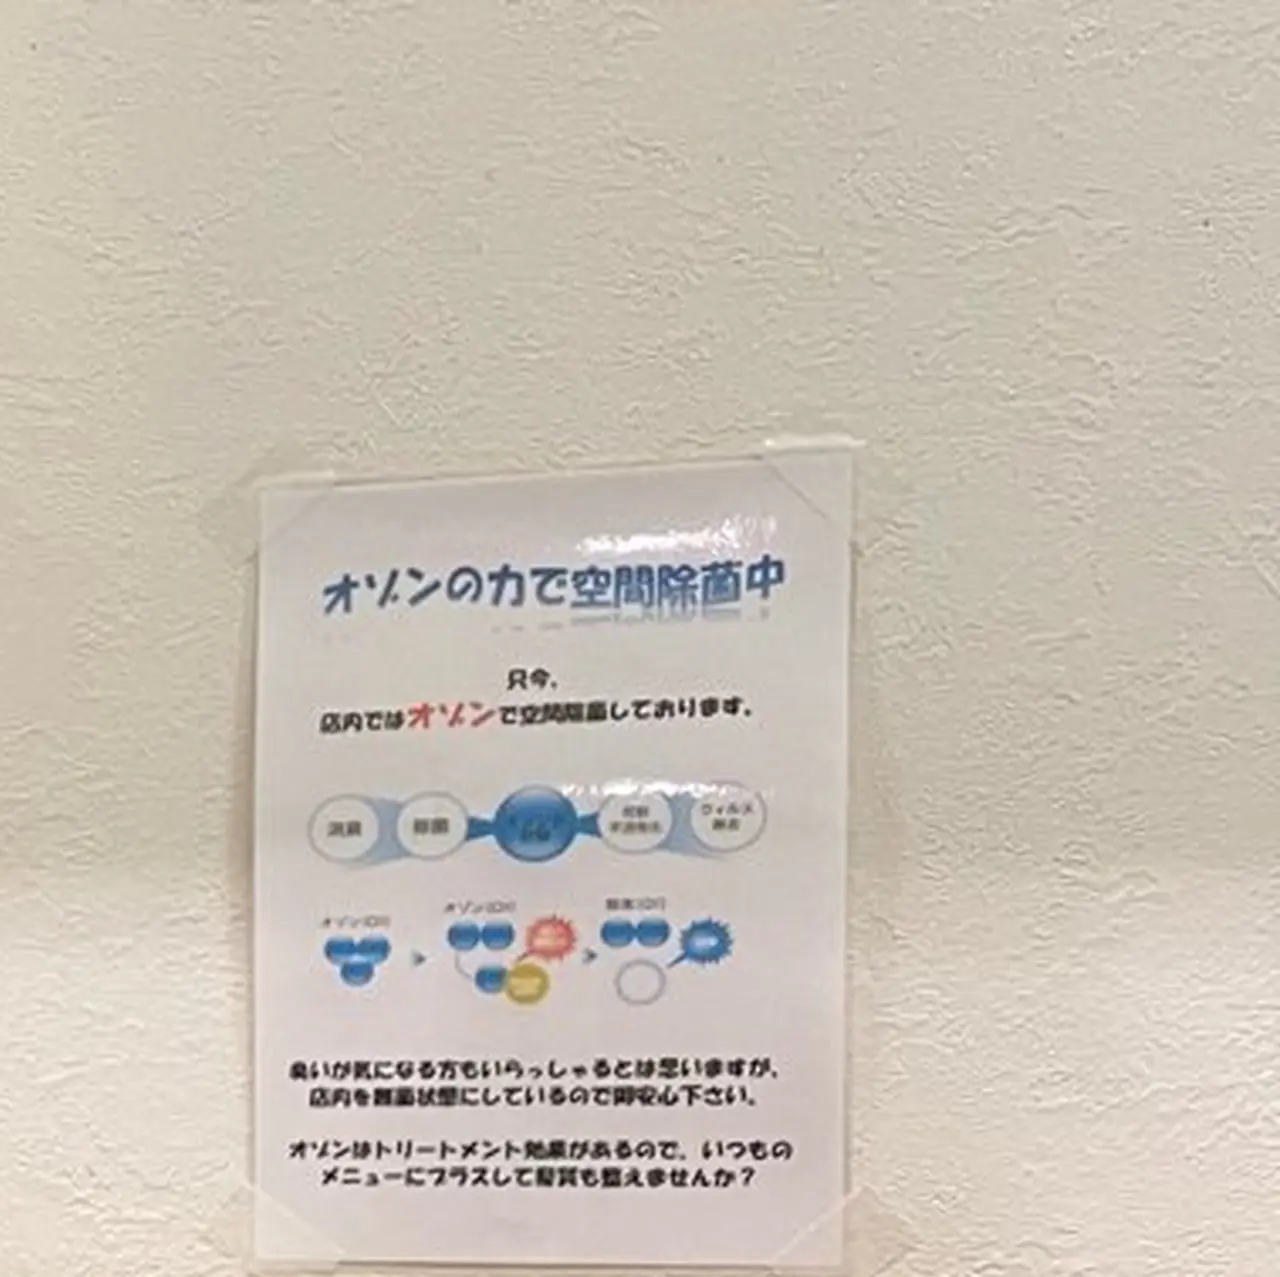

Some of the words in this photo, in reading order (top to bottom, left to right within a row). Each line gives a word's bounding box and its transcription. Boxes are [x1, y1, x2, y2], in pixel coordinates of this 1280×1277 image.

[322, 554, 785, 616] オゾンの力で空間除菌中
[320, 698, 752, 735] 店内ではオゾンで空間除菌しております。
